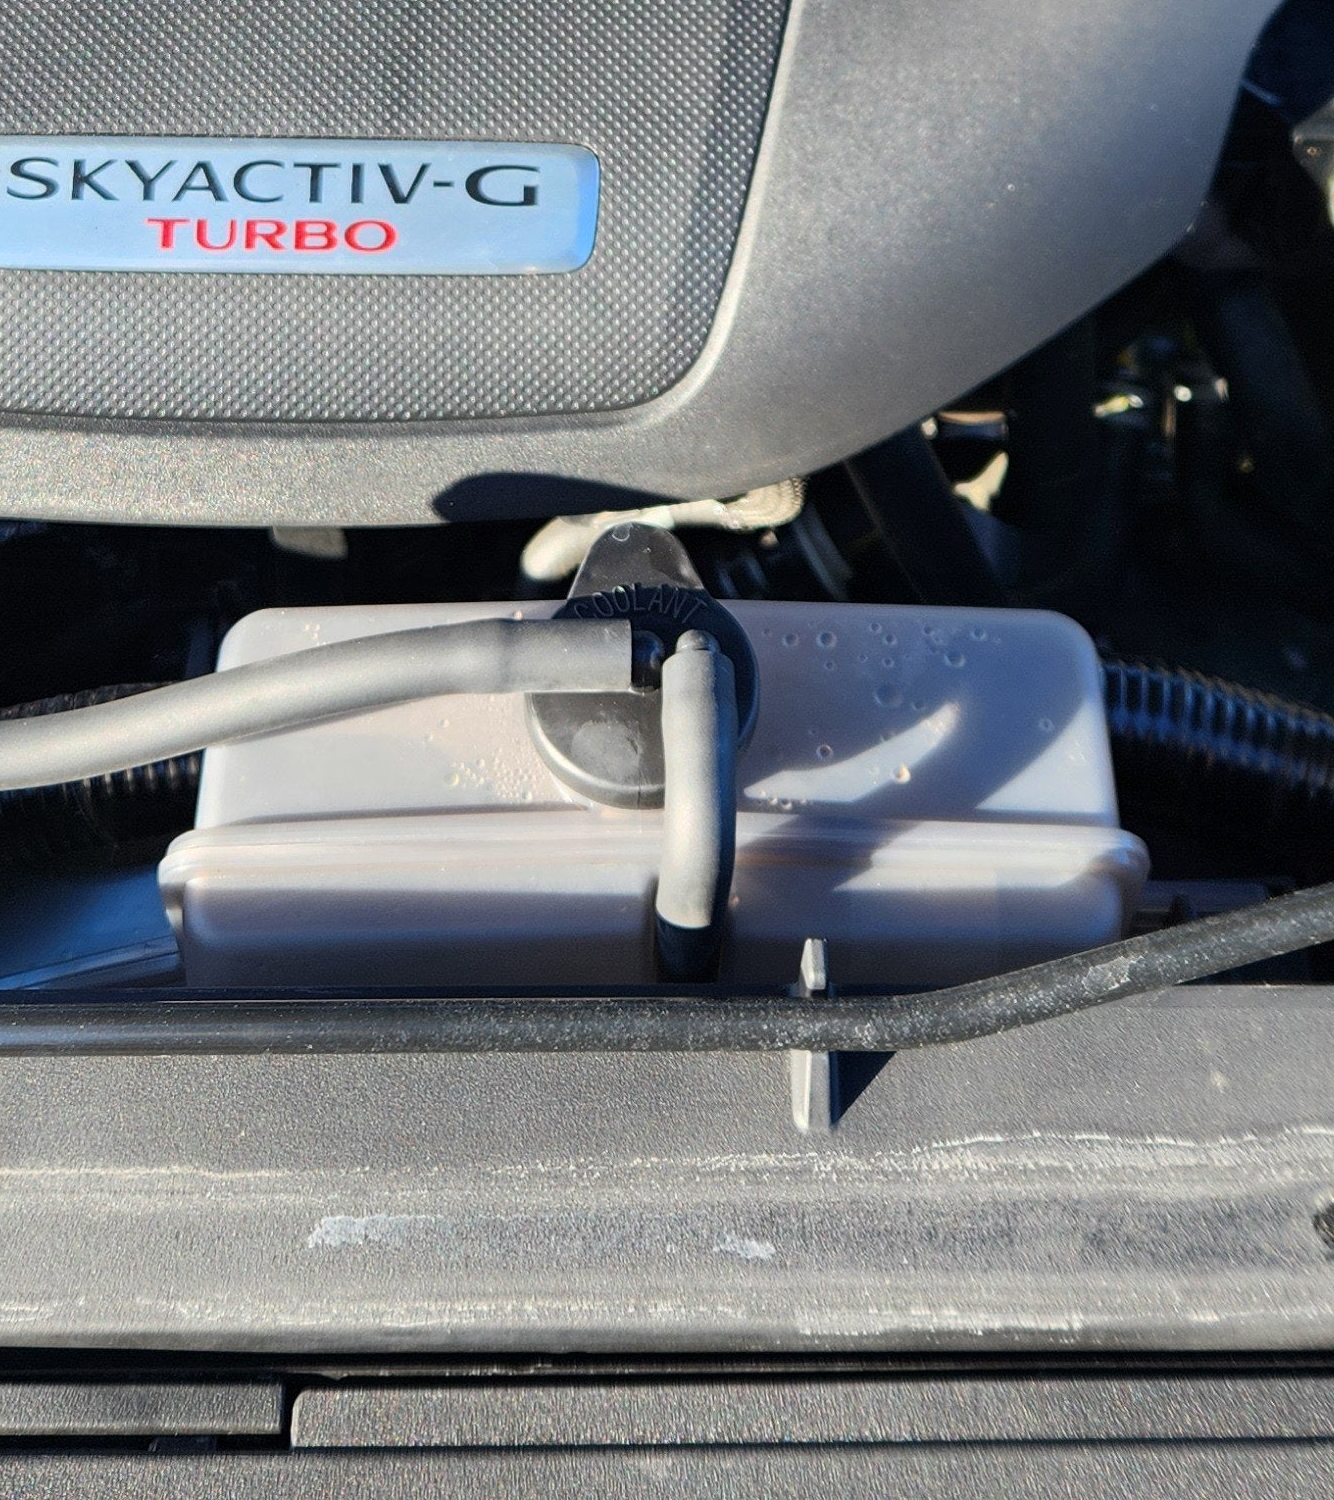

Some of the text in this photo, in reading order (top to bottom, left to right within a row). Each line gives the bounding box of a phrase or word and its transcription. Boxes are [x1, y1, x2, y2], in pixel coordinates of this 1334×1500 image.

[5, 156, 542, 208] SKYACTIV-G
[146, 217, 400, 254] TURBO
[573, 583, 708, 624] COOLANT
